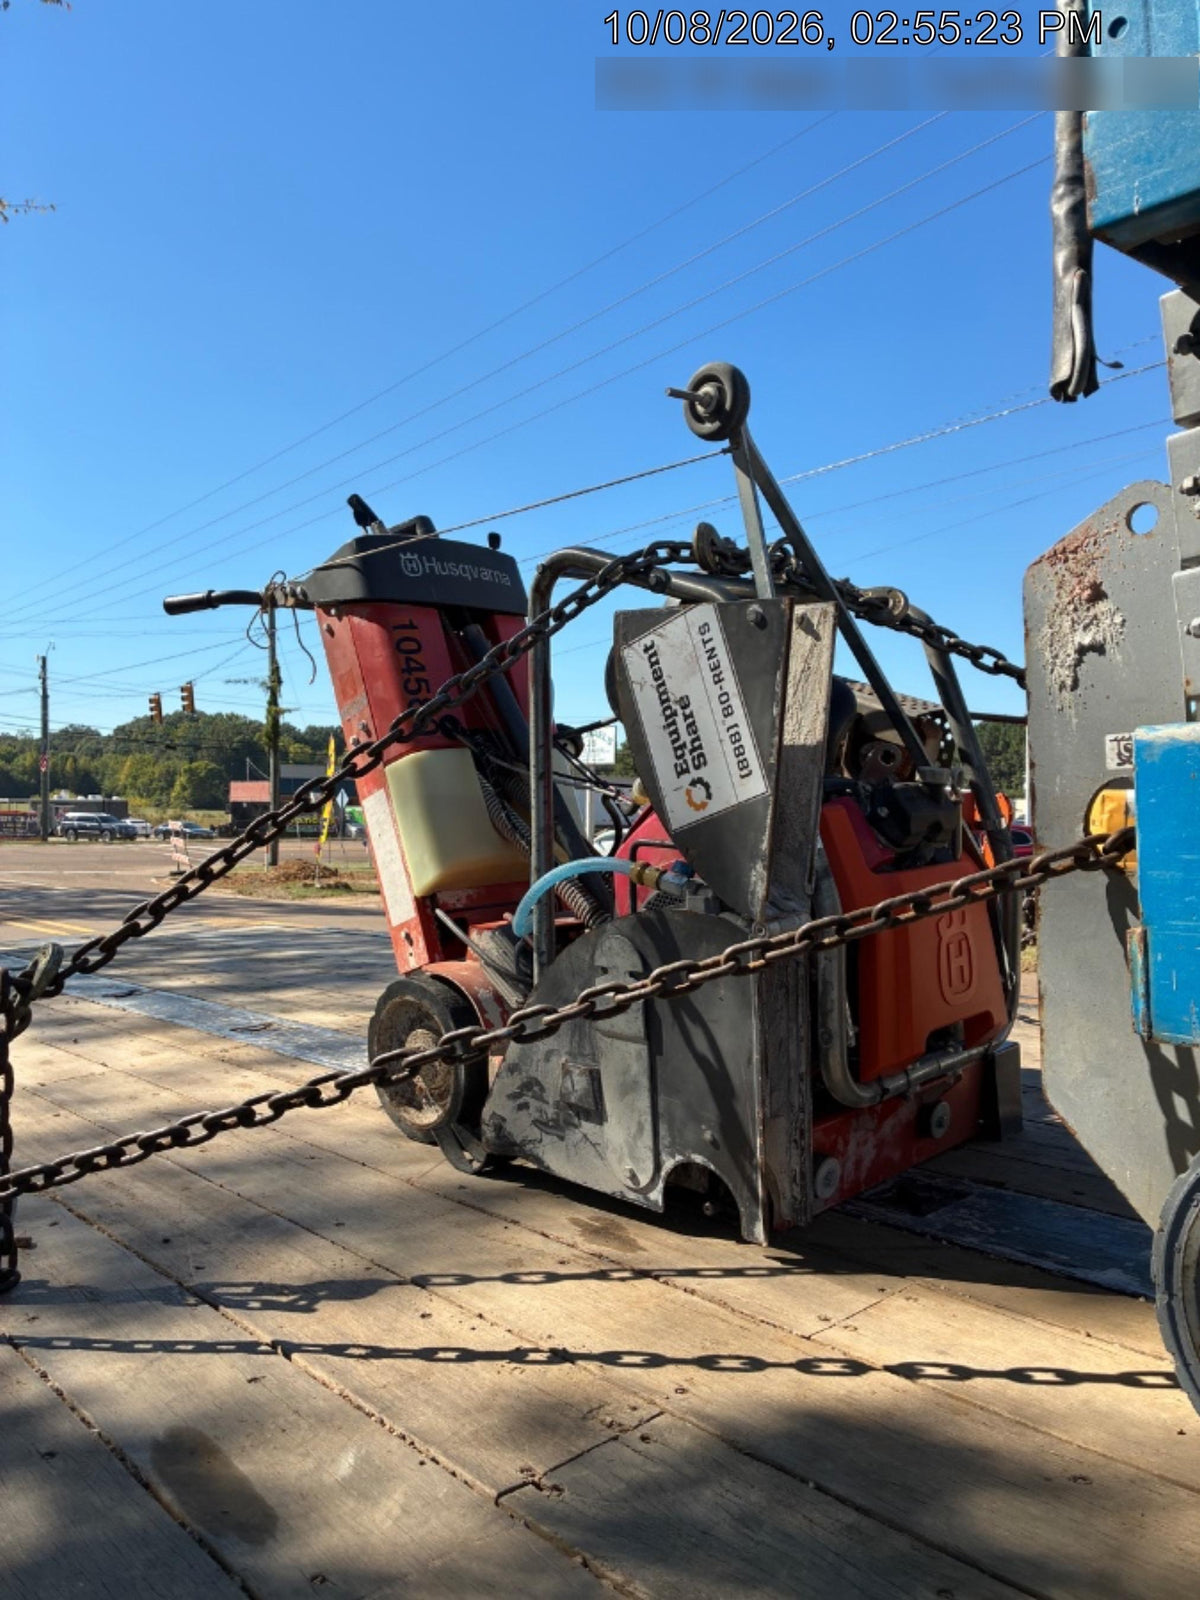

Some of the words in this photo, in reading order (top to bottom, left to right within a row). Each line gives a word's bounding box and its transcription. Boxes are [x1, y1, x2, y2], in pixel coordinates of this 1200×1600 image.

[422, 556, 512, 586] Husqvarna
[698, 621, 735, 719] 80-RENTS
[643, 639, 690, 779] Equipment
[679, 694, 708, 771] Share
[726, 723, 753, 779] (888)
